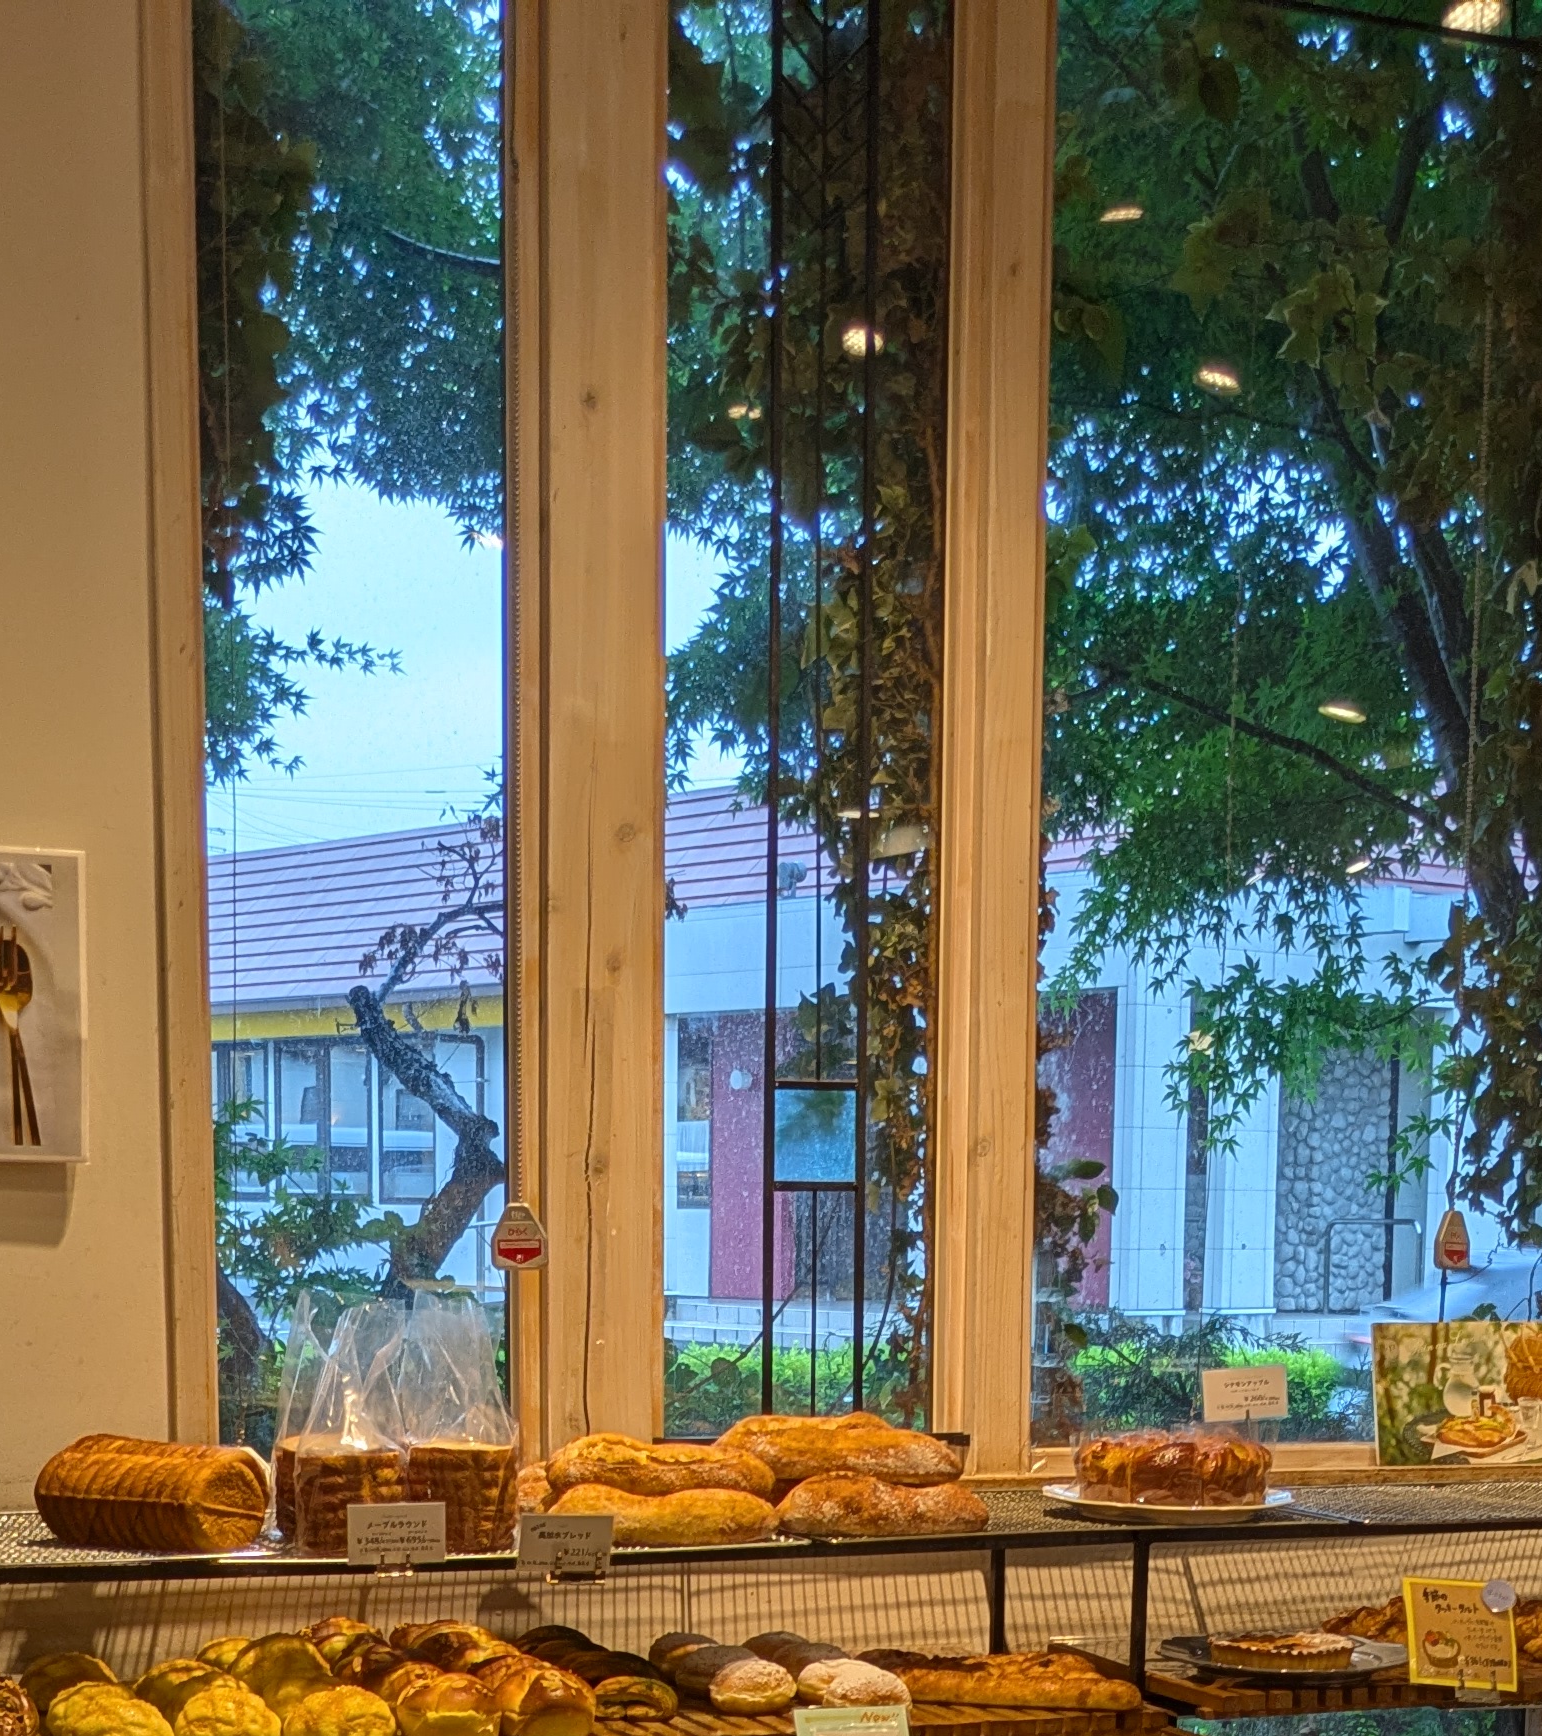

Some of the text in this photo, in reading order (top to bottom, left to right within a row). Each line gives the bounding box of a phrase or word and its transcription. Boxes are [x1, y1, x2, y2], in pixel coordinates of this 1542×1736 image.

[367, 1519, 428, 1531] メープルラウンド
[860, 1711, 902, 1724] New!!
